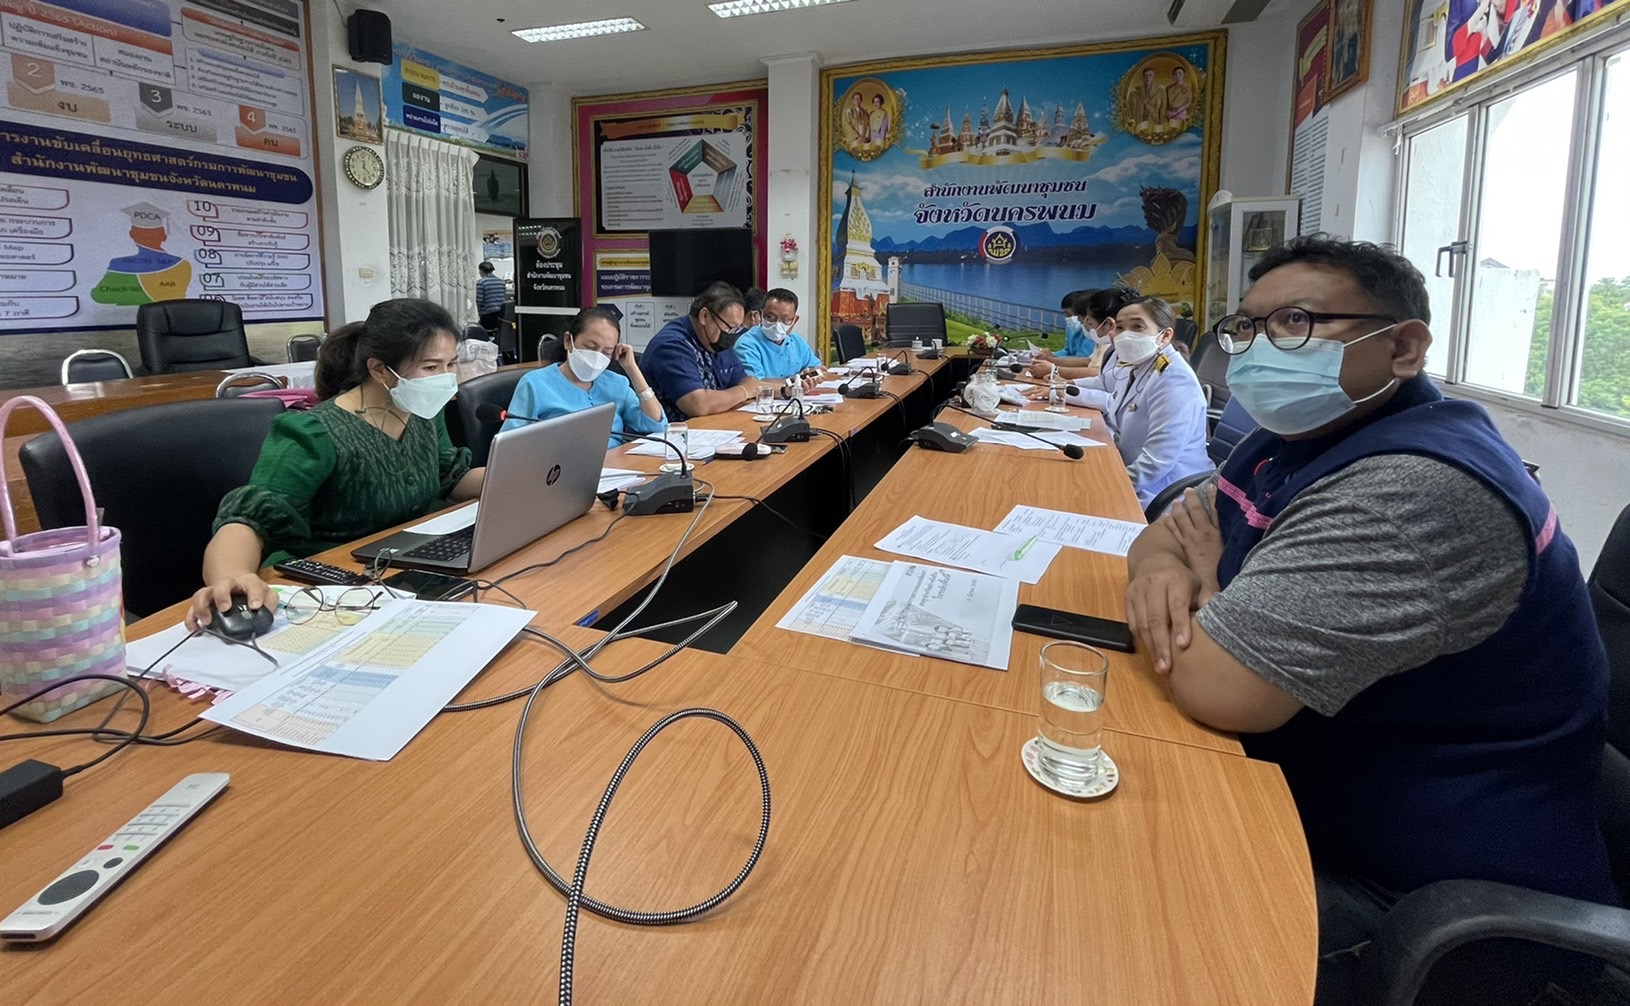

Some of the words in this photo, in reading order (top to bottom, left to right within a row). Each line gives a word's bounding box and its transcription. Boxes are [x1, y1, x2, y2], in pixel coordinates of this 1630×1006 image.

[27, 62, 42, 78] 2
[81, 83, 105, 95] 2565
[150, 89, 162, 103] 3
[57, 101, 78, 113] งบ
[192, 107, 212, 117] 2565
[247, 111, 256, 124] 4
[166, 120, 198, 133] ระบบ
[263, 138, 279, 147] คน
[923, 180, 1088, 199] สำนักงานพัฒนาชุมชน
[194, 200, 212, 212] 10
[134, 211, 162, 221] PDCA
[913, 201, 1098, 224] จังหวัดนครพนม
[197, 225, 215, 237] 09
[198, 248, 217, 260] 08
[203, 272, 221, 283] 07
